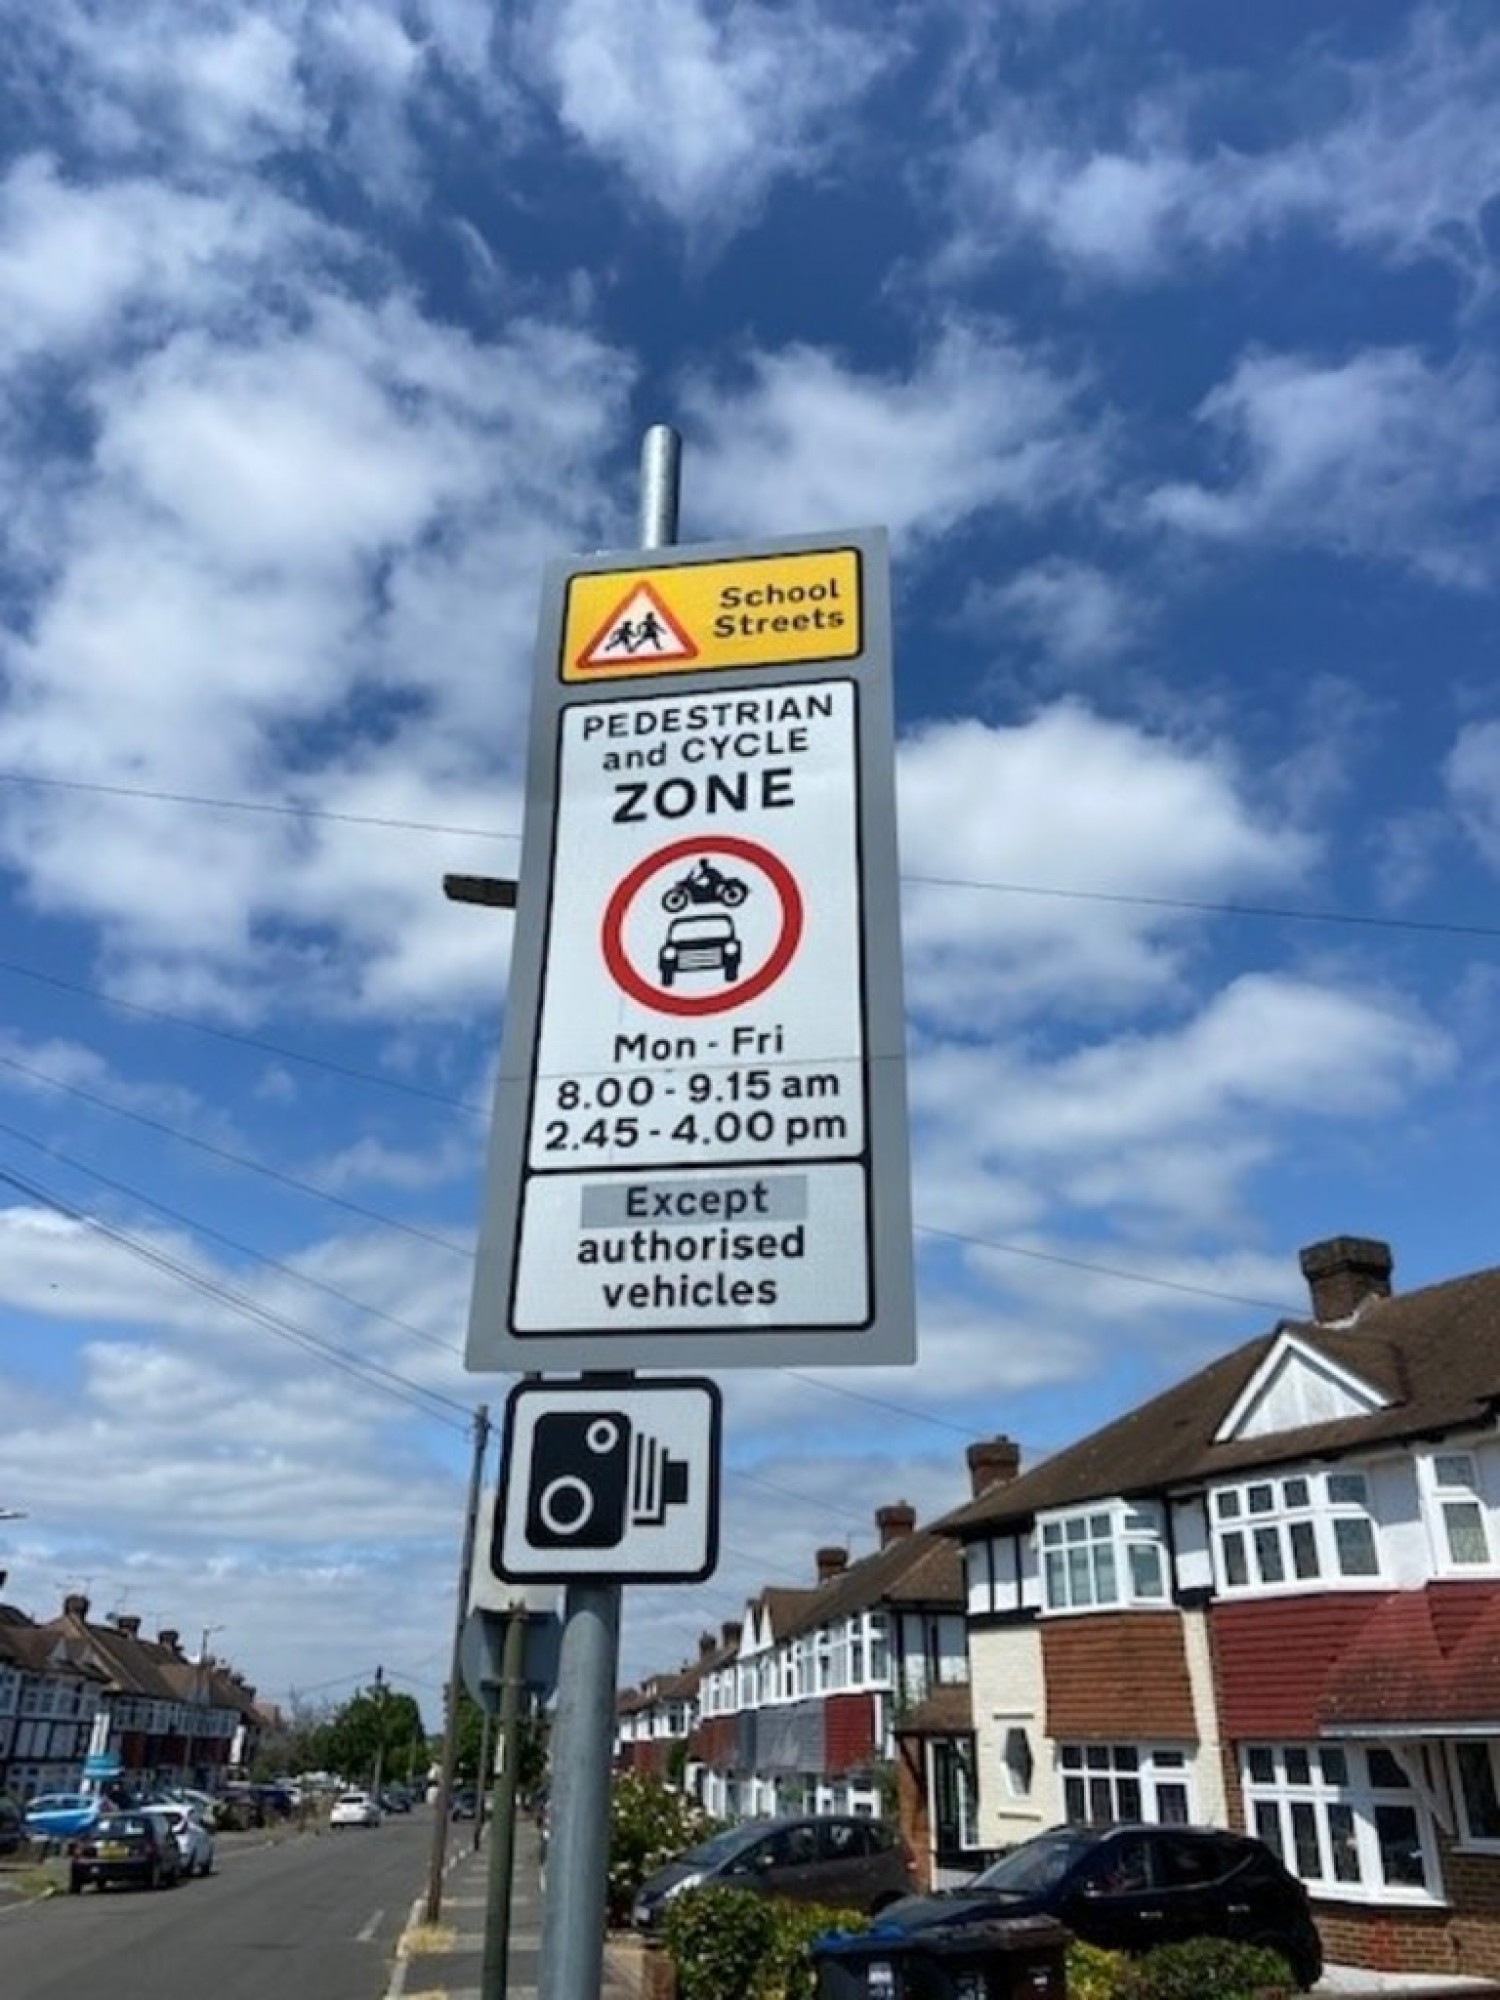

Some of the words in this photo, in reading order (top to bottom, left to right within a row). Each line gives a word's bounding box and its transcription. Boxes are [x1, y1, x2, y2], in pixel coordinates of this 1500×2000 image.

[720, 578, 839, 609] School
[713, 607, 845, 638] Streets
[583, 693, 833, 740] PEDESTRIAN
[602, 741, 667, 771] and
[681, 727, 809, 763] CYCLE
[612, 767, 795, 823] ZONE
[613, 1033, 696, 1063] Mon
[732, 1024, 784, 1055] Fri
[557, 1076, 654, 1110] 8.00
[688, 1071, 771, 1103] 9.15
[782, 1073, 839, 1098] am
[545, 1117, 639, 1150] 2.45
[671, 1110, 774, 1145] 4.00
[786, 1114, 847, 1146] pm
[625, 1180, 769, 1220] Except
[577, 1224, 805, 1264] authorised
[602, 1272, 778, 1309] vehicles
